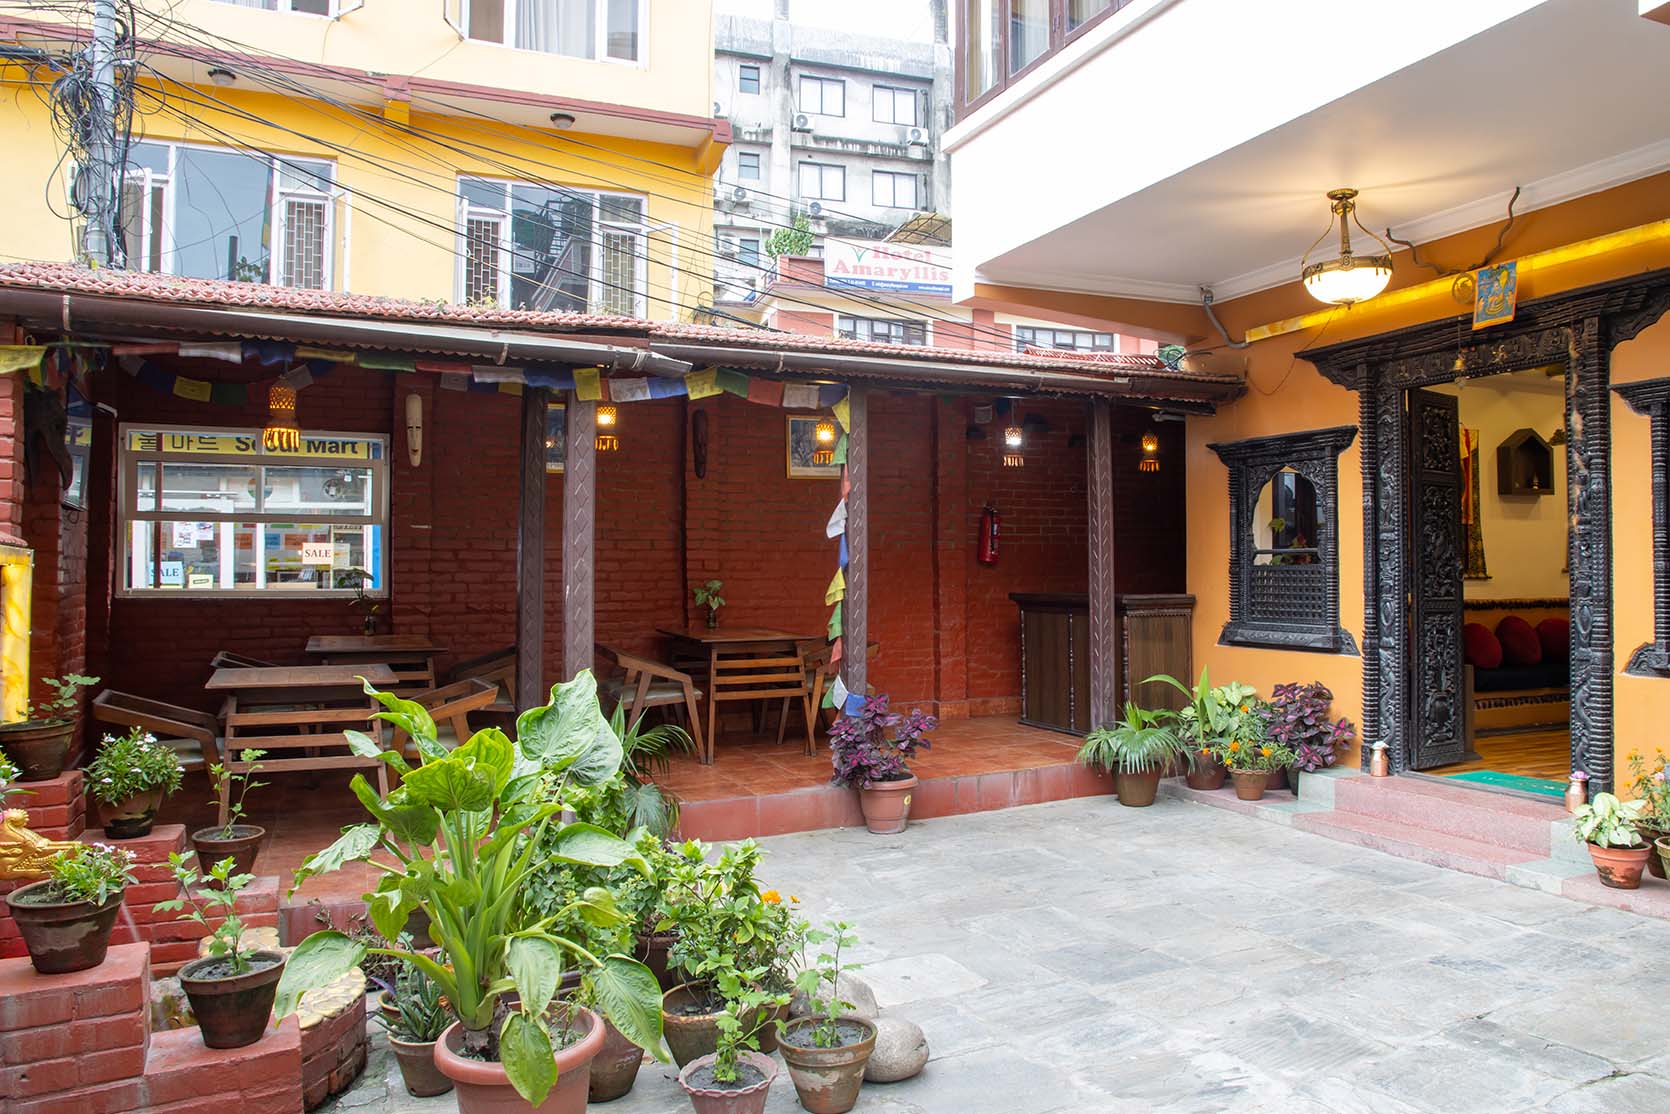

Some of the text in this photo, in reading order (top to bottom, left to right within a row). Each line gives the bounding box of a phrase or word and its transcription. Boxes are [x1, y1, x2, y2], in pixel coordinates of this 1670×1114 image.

[872, 246, 933, 262] Hotel
[833, 259, 950, 281] Amaryllis
[306, 439, 359, 455] Mart
[304, 548, 332, 558] SALE
